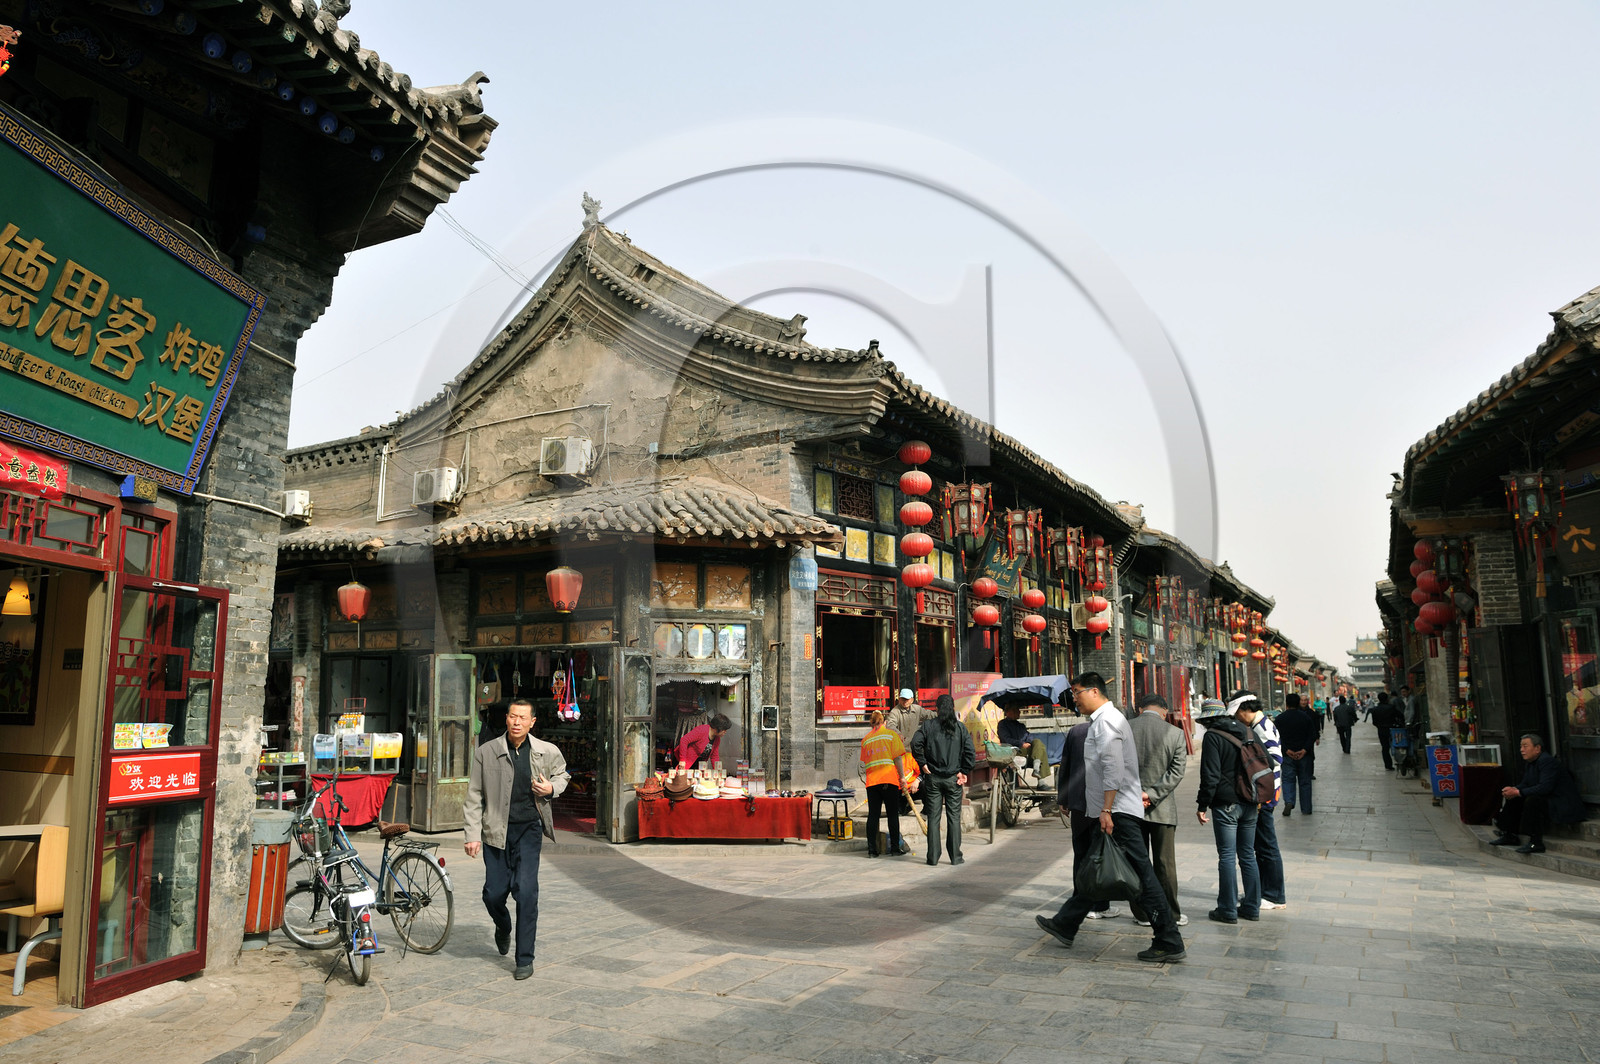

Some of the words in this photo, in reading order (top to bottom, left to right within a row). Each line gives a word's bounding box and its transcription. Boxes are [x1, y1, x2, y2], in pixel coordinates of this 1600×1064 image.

[159, 321, 226, 388] 炸鸡
[44, 366, 56, 381] &
[56, 370, 87, 393] Roast
[137, 381, 205, 444] 汉堡
[0, 453, 59, 489] 意盎然
[129, 772, 197, 791] 欢迎光临
[1434, 747, 1455, 792] 香草肉
